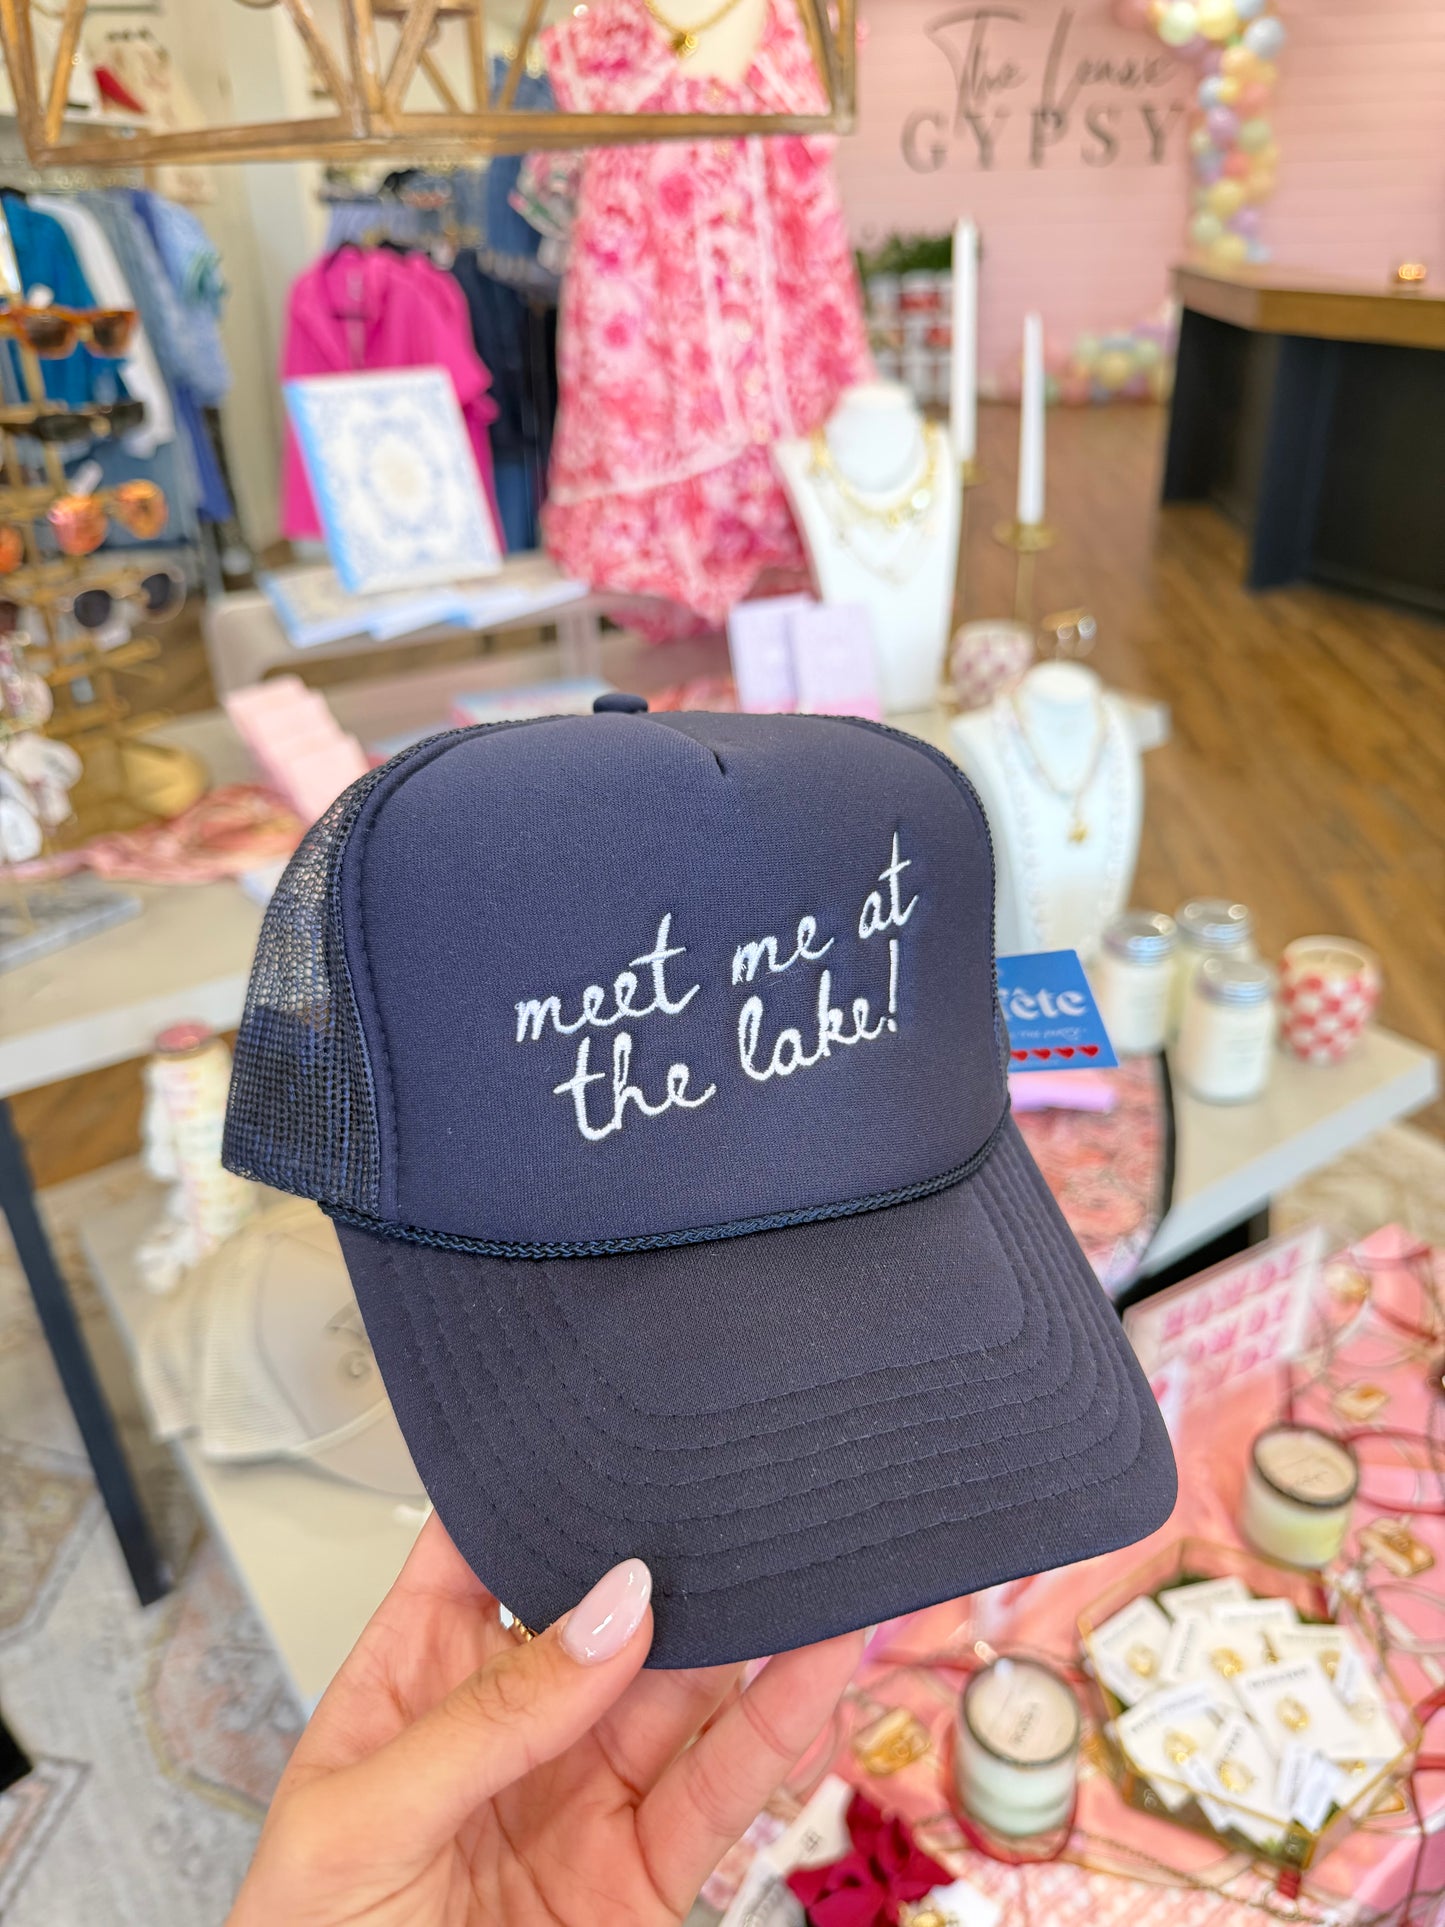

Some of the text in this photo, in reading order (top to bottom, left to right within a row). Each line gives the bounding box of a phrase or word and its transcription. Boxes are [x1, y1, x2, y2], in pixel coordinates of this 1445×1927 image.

[900, 100, 1188, 174] GYPSY
[923, 4, 1028, 138] The
[515, 831, 919, 1042] meet me at
[553, 939, 899, 1141] the lake!
